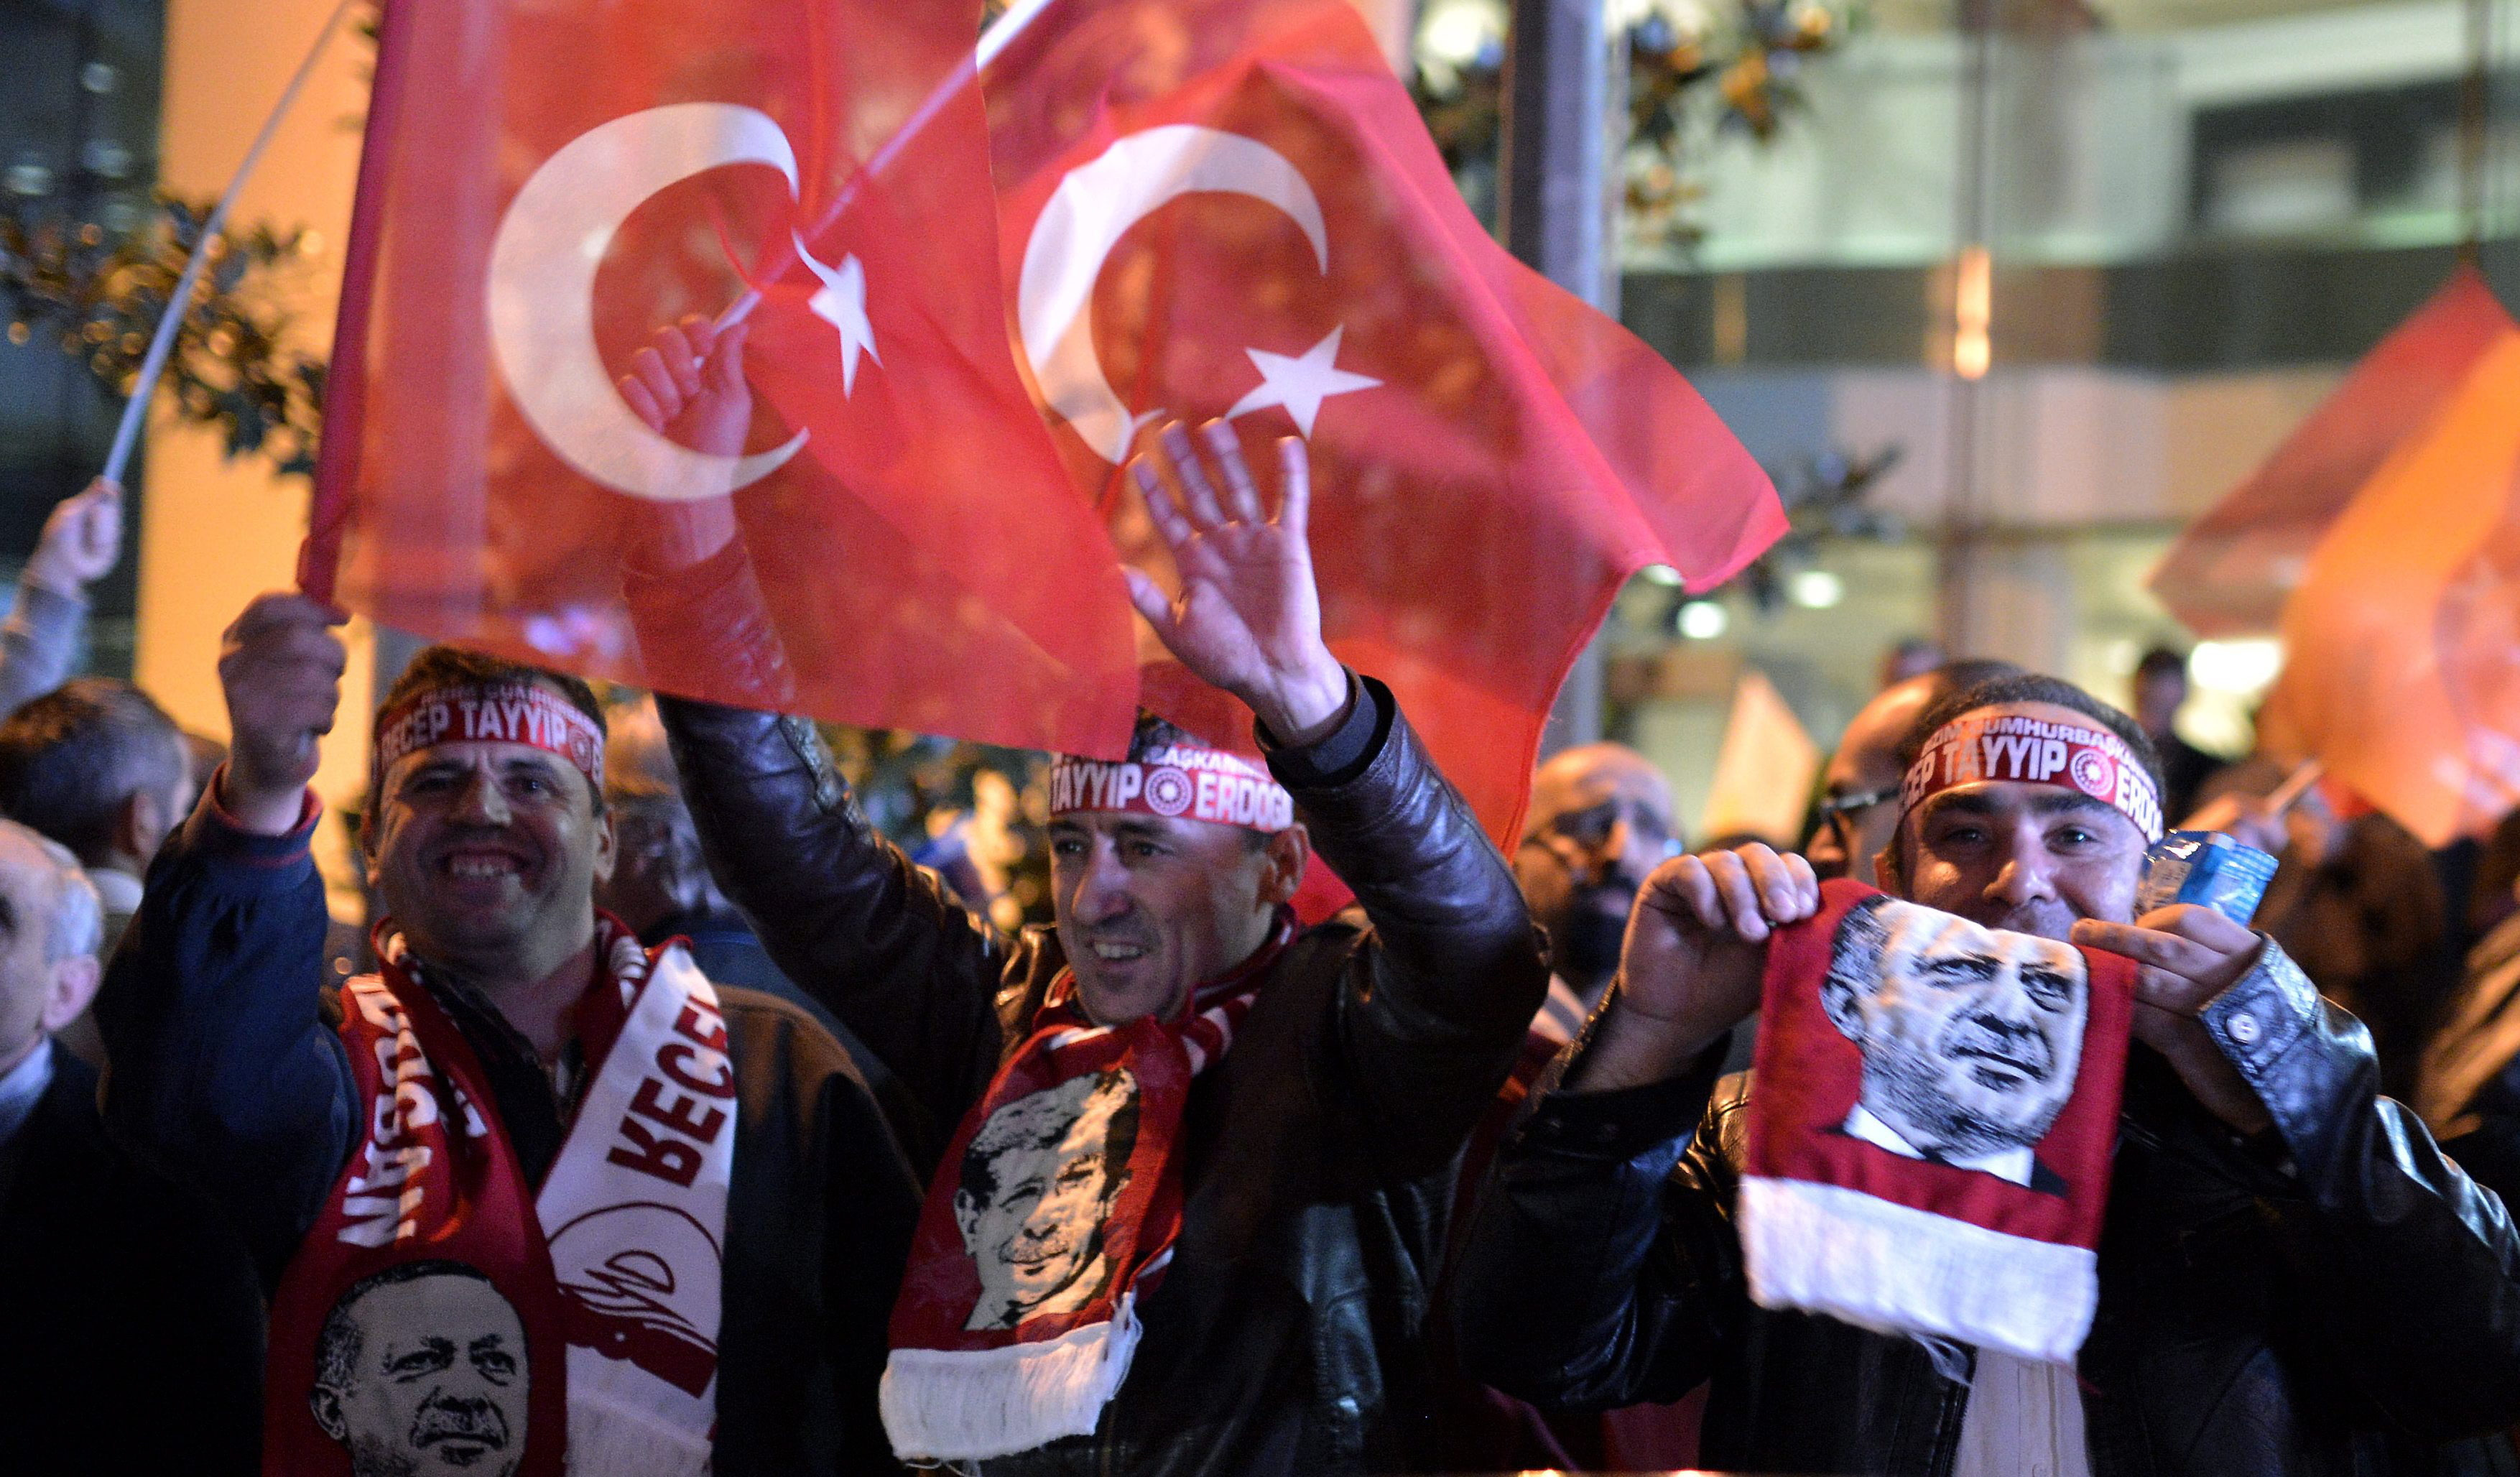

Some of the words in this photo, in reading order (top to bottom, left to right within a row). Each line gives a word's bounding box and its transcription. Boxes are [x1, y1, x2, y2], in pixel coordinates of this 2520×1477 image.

[459, 700, 568, 751] TAYYIP
[1942, 735, 2067, 785] TAYYIP
[2114, 763, 2164, 846] ERDO
